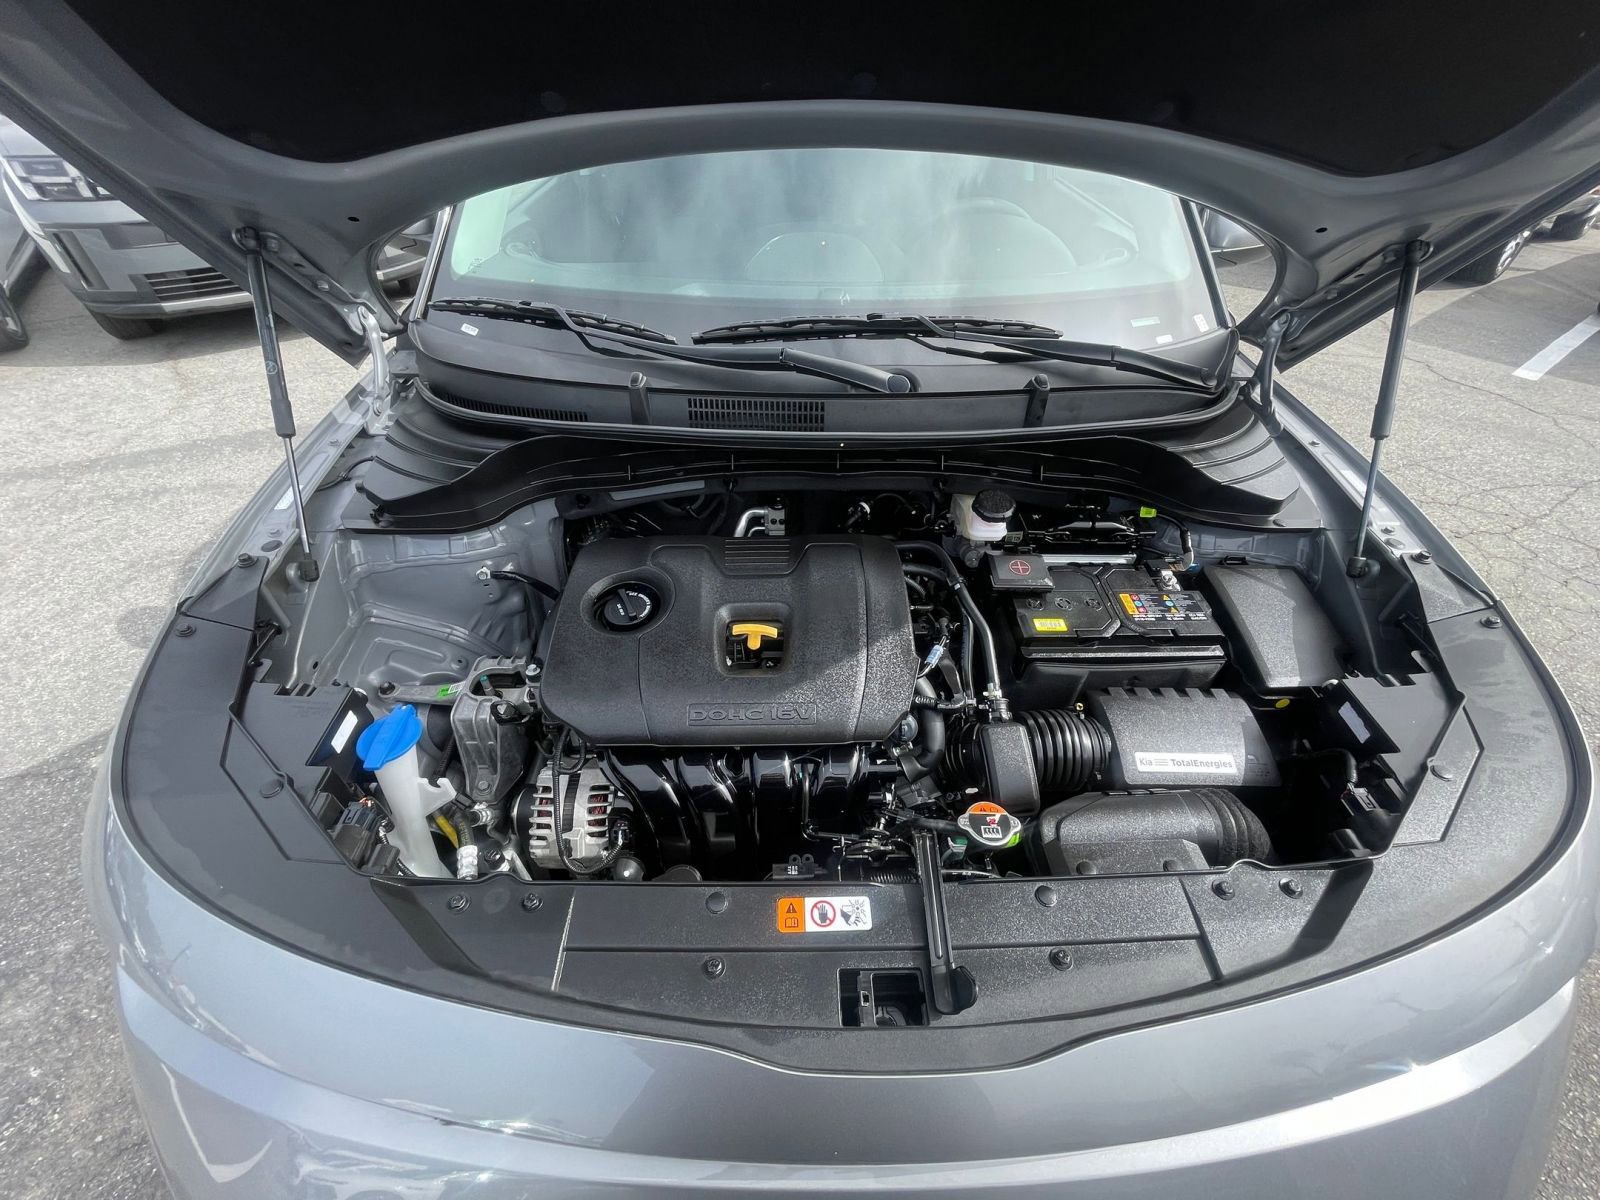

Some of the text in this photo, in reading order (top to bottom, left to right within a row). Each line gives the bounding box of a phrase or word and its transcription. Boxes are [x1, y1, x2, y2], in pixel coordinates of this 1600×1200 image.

[689, 704, 814, 721] DOHC 16V
[1138, 757, 1233, 769] Kia TotalEnergies
